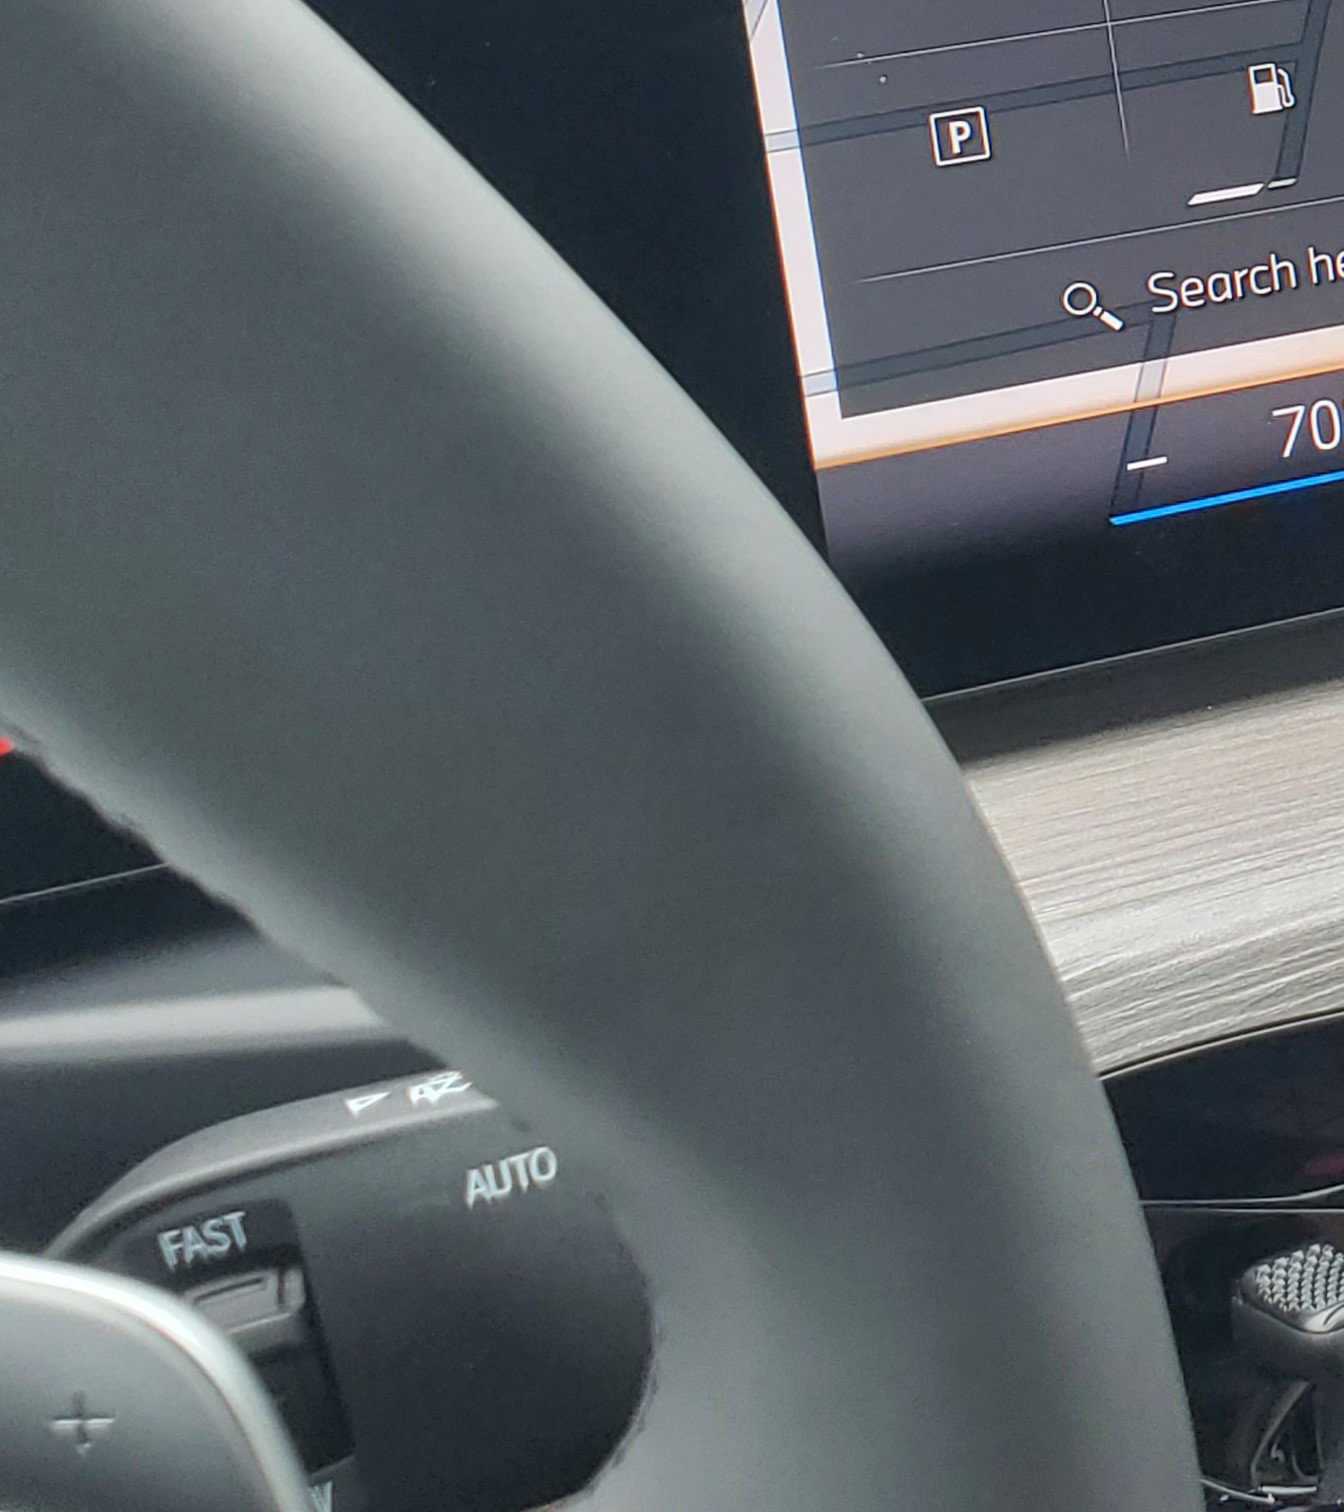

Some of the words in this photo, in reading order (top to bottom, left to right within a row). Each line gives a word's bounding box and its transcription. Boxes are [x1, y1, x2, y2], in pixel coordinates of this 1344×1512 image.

[1147, 253, 1299, 314] Search
[465, 1146, 558, 1209] AUTO
[158, 1211, 248, 1273] FAST
